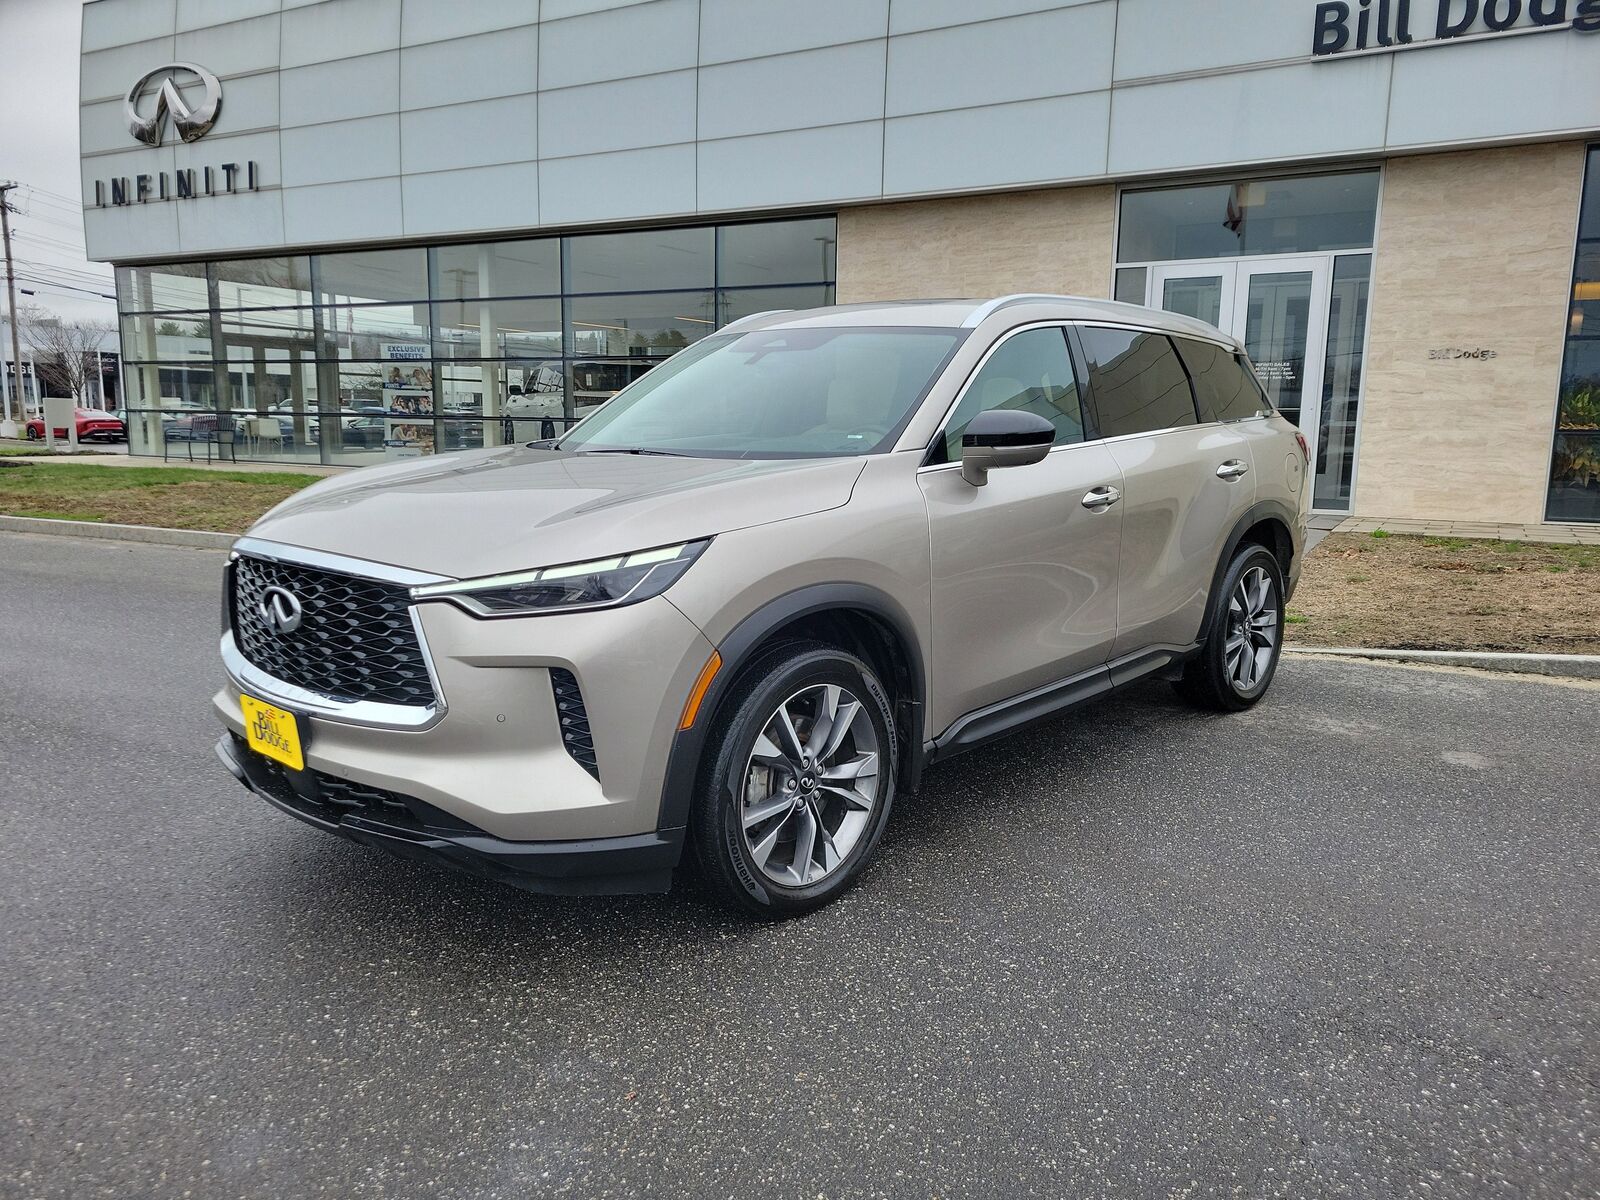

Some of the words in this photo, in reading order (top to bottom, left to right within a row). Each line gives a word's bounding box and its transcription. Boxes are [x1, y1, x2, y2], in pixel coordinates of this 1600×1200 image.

[1313, 0, 1412, 55] Bill
[95, 160, 258, 206] INFINITI
[387, 345, 426, 353] EXCLUSIVE
[1454, 347, 1497, 361] Dodge
[253, 721, 292, 753] DODGE
[257, 710, 282, 737] BILL
